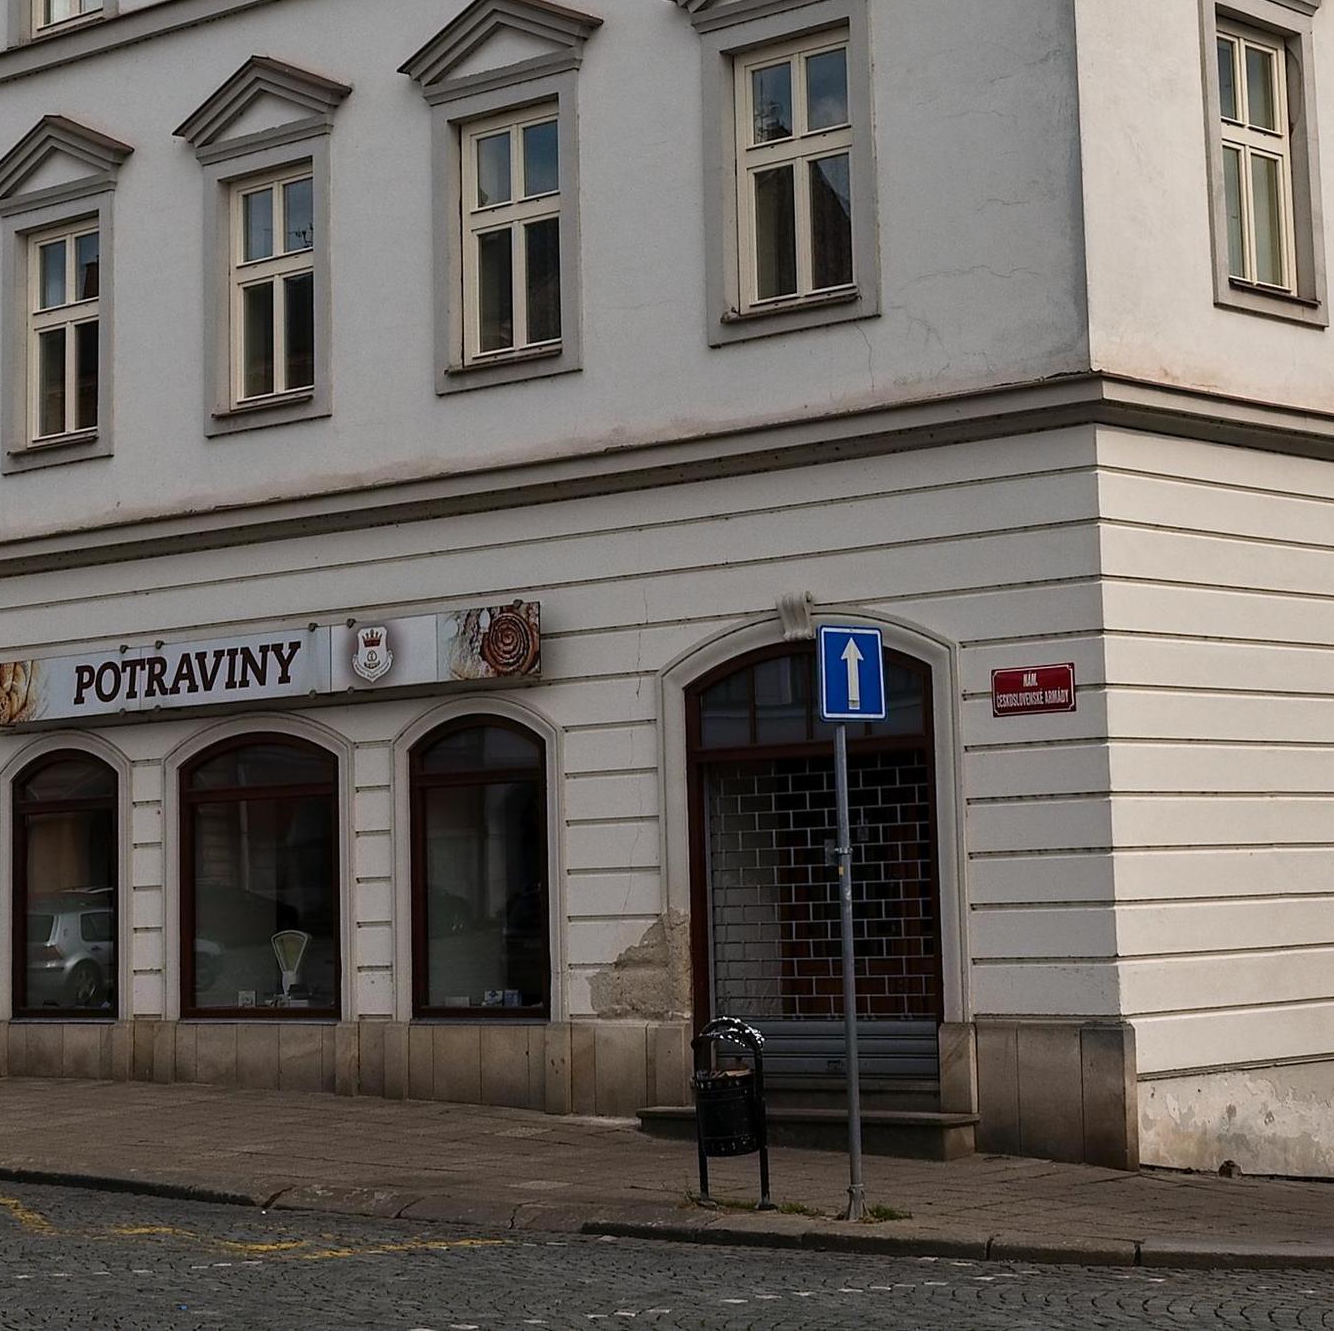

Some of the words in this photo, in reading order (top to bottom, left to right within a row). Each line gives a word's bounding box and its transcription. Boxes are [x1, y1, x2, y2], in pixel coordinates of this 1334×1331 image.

[74, 640, 302, 705] POTRAVINY
[1023, 671, 1038, 687] NÁM.
[996, 688, 1044, 707] ČESKOSLOVENSKÉ
[1044, 686, 1069, 704] ARMÁDY
